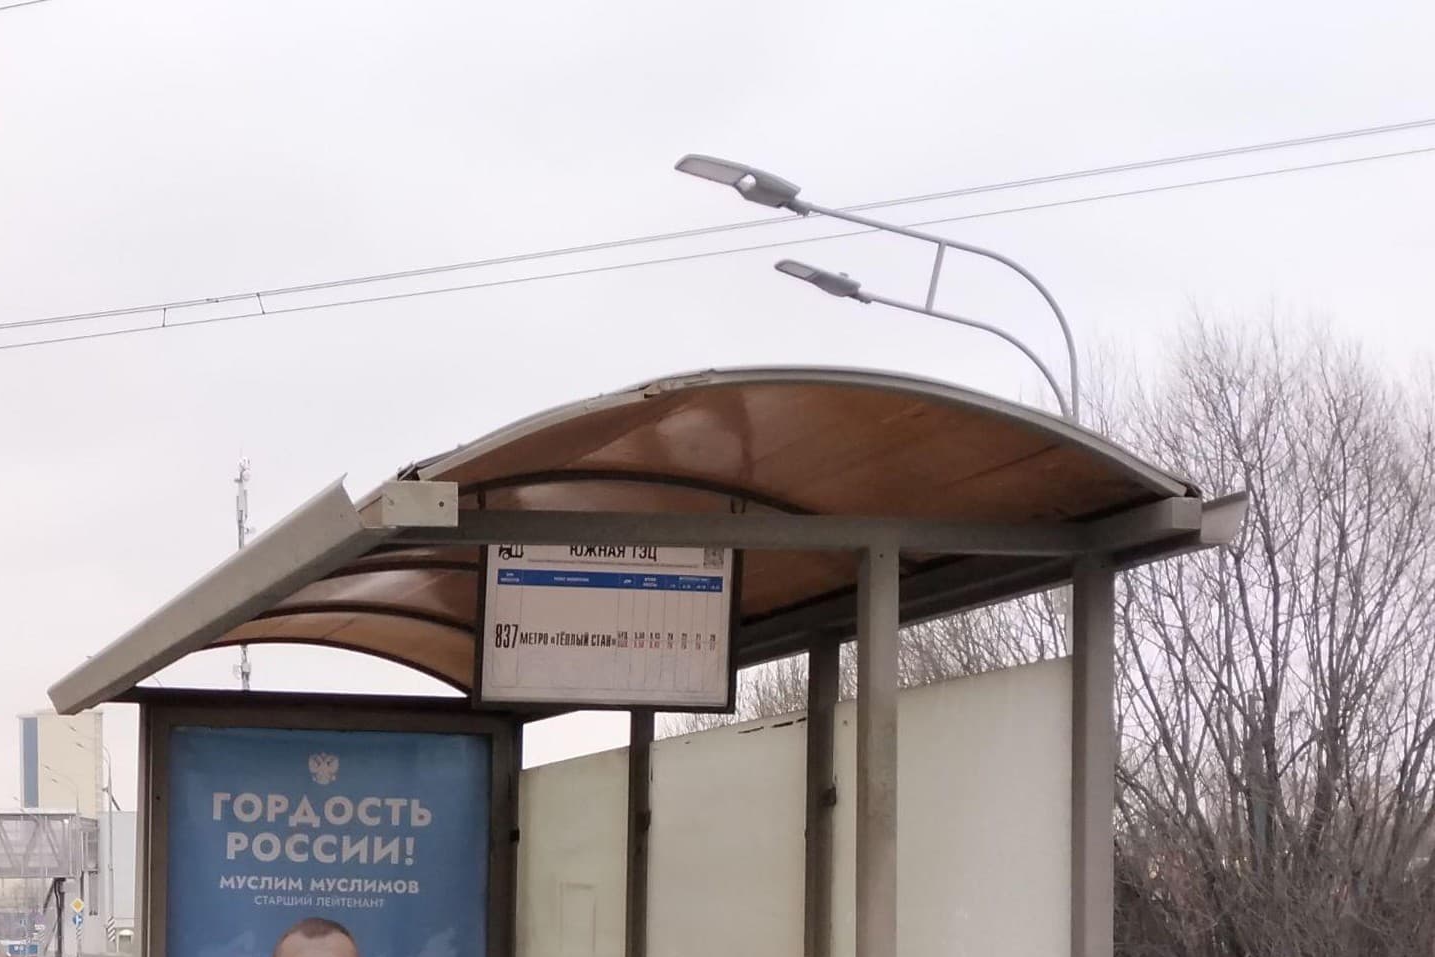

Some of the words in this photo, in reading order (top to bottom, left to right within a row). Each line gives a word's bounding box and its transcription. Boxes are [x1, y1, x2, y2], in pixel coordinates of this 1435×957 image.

[569, 545, 627, 558] ЮЖНАЯ
[631, 546, 658, 562] ТЭЦ
[495, 624, 519, 649] 837
[519, 632, 549, 646] МЕТРО
[212, 793, 432, 828] ГОРДОСТЬ
[226, 832, 416, 866] РОССИИ!
[219, 875, 303, 891] МУСЛИМ
[309, 877, 420, 894] МУСЛИМОВ
[254, 894, 313, 908] СТАРШИЙ
[316, 896, 385, 909] ЛЕЙТЕНАНТ
